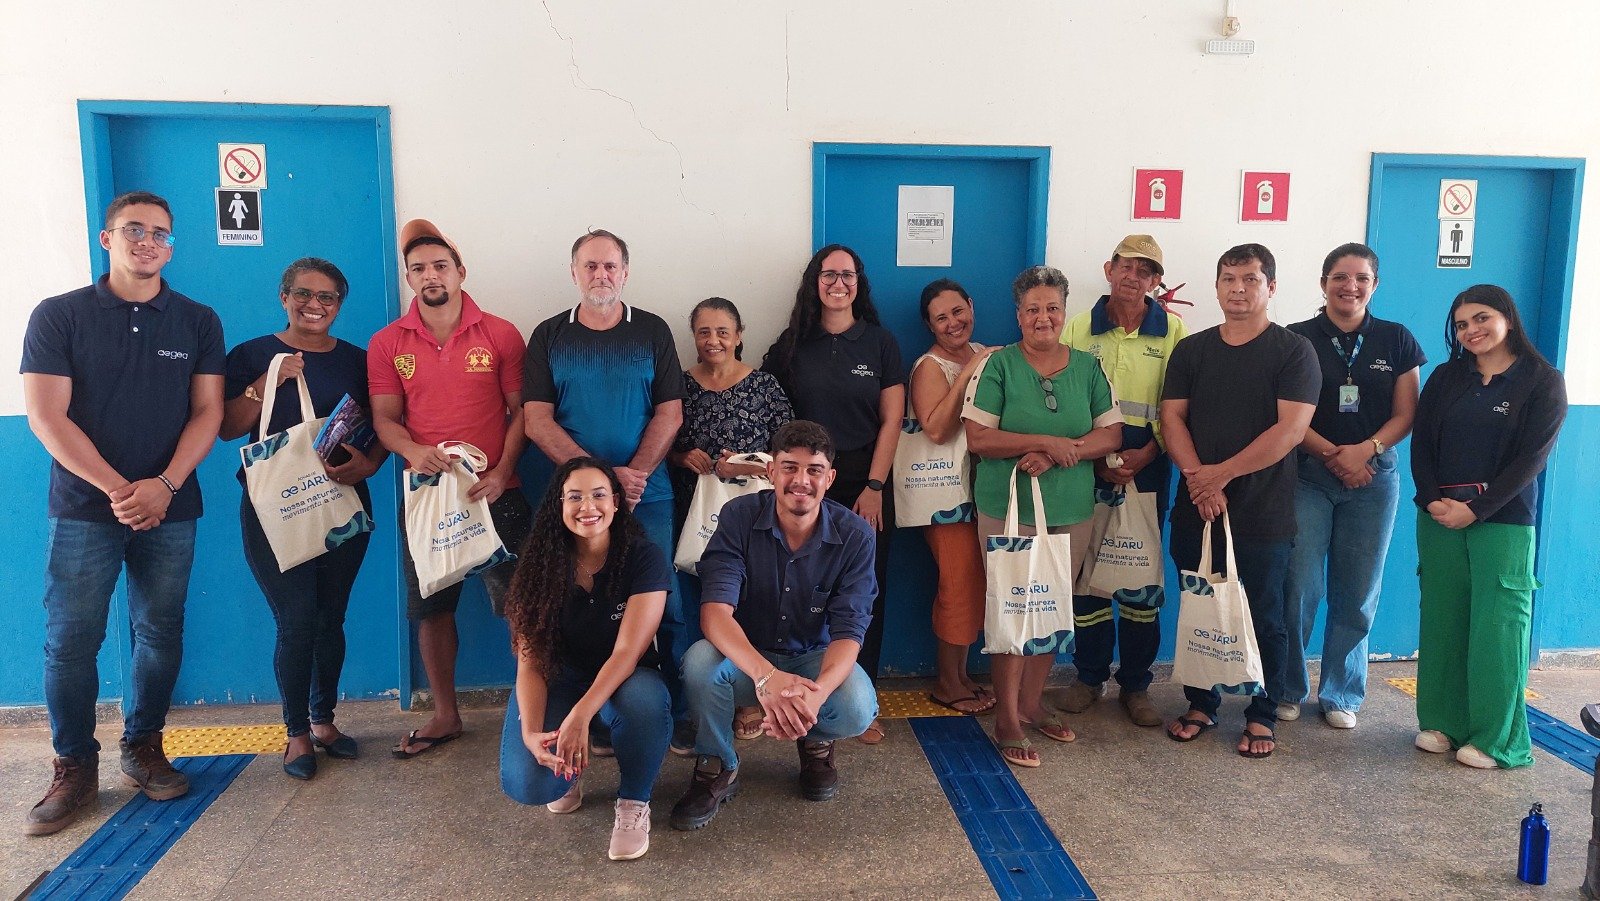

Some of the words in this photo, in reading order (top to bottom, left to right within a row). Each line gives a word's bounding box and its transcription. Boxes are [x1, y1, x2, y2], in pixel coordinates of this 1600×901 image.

[222, 233, 258, 241] FEMININO
[157, 349, 189, 360] aegea
[851, 369, 874, 377] aegea
[1369, 364, 1393, 372] aegea
[926, 461, 954, 471] JARU
[279, 500, 306, 515] Nossa
[282, 501, 323, 522] movimenta
[469, 527, 487, 538] vida
[1115, 540, 1144, 549] JARU
[1097, 551, 1114, 559] ossa
[1115, 553, 1149, 561] natureza
[1096, 558, 1127, 566] ovimenta
[1005, 601, 1026, 609] Nossa
[1211, 634, 1238, 645] JARU
[1188, 639, 1211, 651] Nossa
[1212, 648, 1244, 657] natureza
[1187, 646, 1223, 661] movimenta
[1229, 655, 1245, 663] vida
